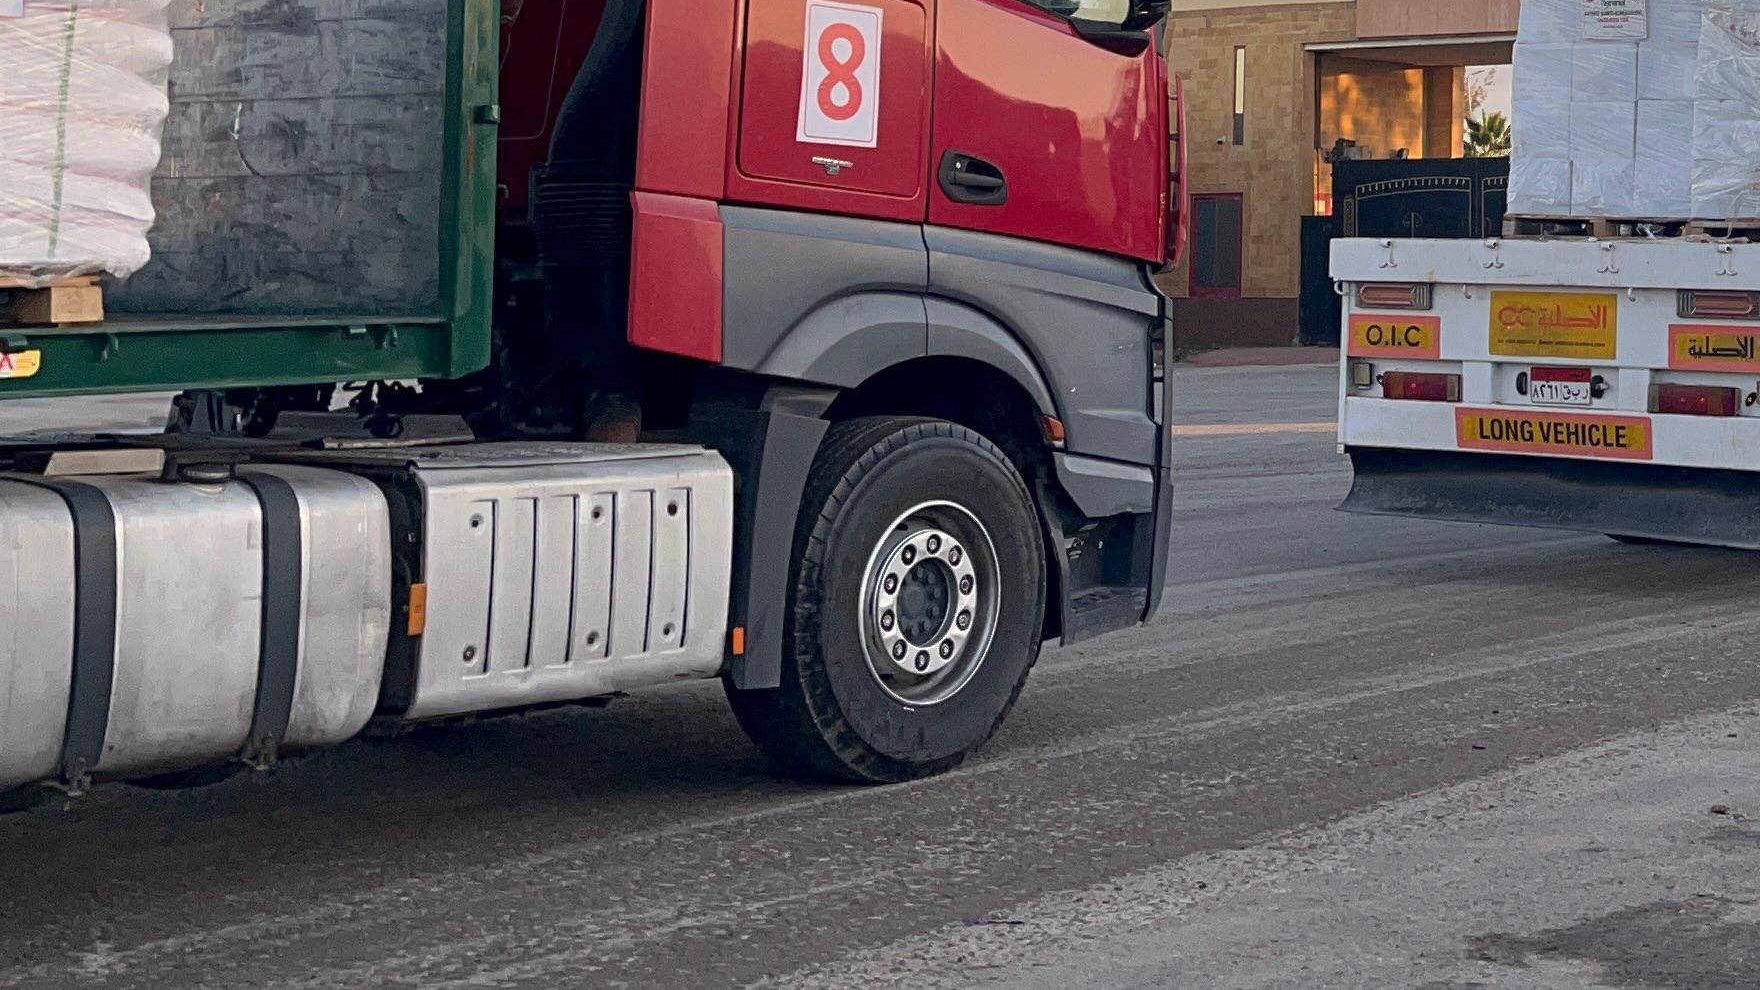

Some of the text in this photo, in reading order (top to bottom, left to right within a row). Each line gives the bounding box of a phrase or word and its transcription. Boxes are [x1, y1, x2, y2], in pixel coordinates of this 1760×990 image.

[817, 22, 866, 121] 8
[1366, 324, 1421, 347] O.I.C
[1688, 335, 1754, 359] الاصلية
[1479, 417, 1627, 448] LONG VEHICLE
